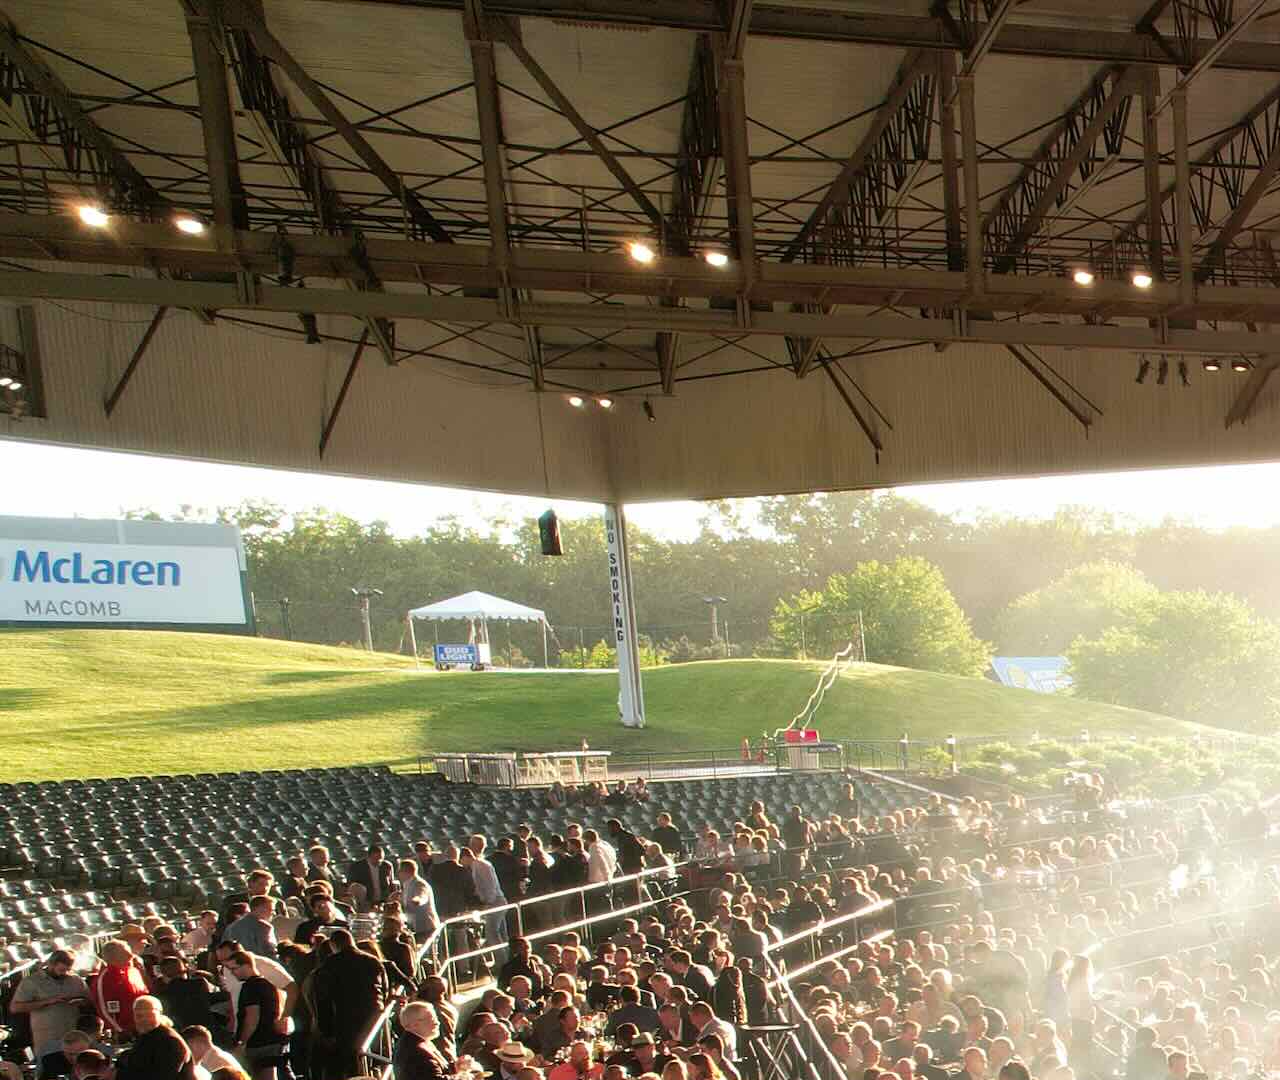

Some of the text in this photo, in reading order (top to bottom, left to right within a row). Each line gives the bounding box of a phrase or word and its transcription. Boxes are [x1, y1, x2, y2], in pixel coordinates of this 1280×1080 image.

[12, 550, 181, 586] McLaren
[24, 599, 121, 617] MACOMB
[609, 553, 624, 641] SMOKING
